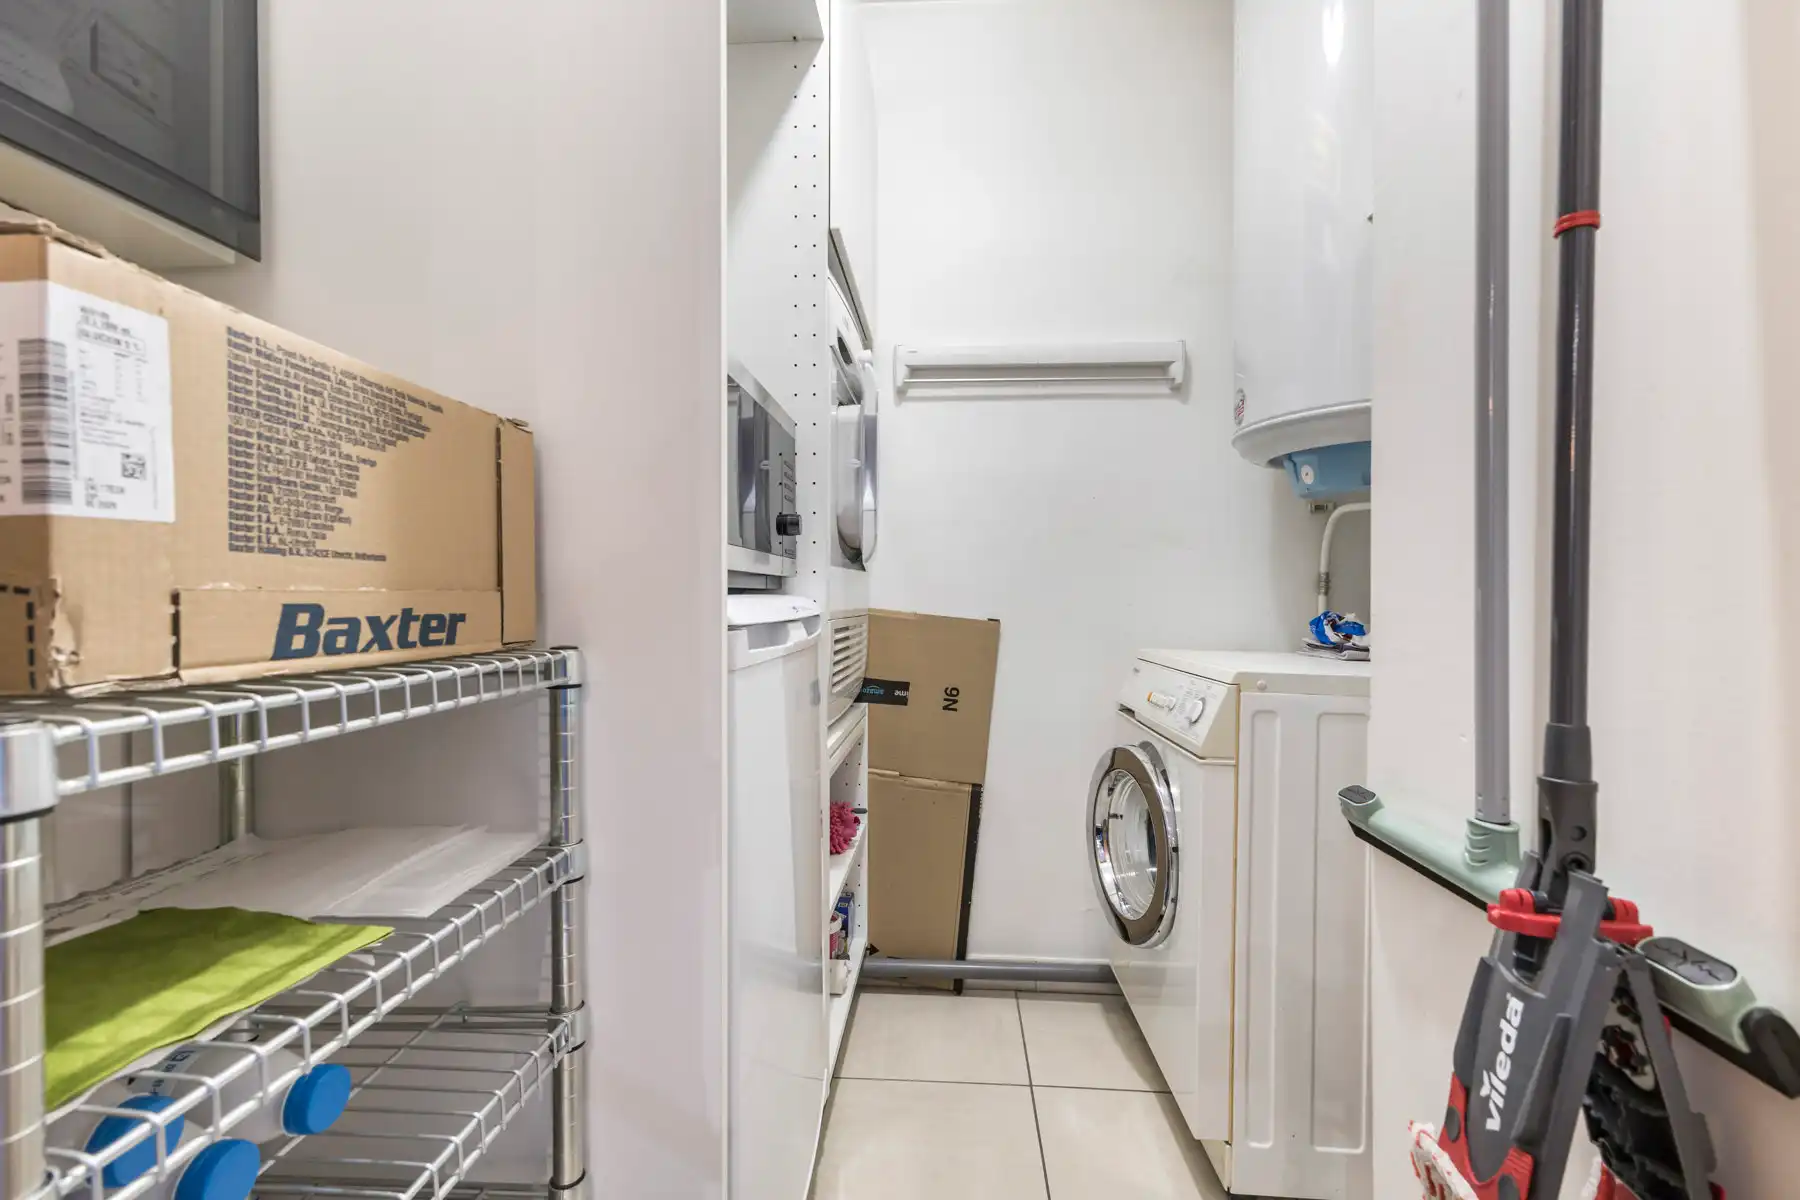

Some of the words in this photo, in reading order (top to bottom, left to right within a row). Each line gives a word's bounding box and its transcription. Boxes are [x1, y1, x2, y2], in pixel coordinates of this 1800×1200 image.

[271, 603, 467, 660] Baxter
[943, 686, 960, 712] N6
[1480, 994, 1524, 1131] vileda
